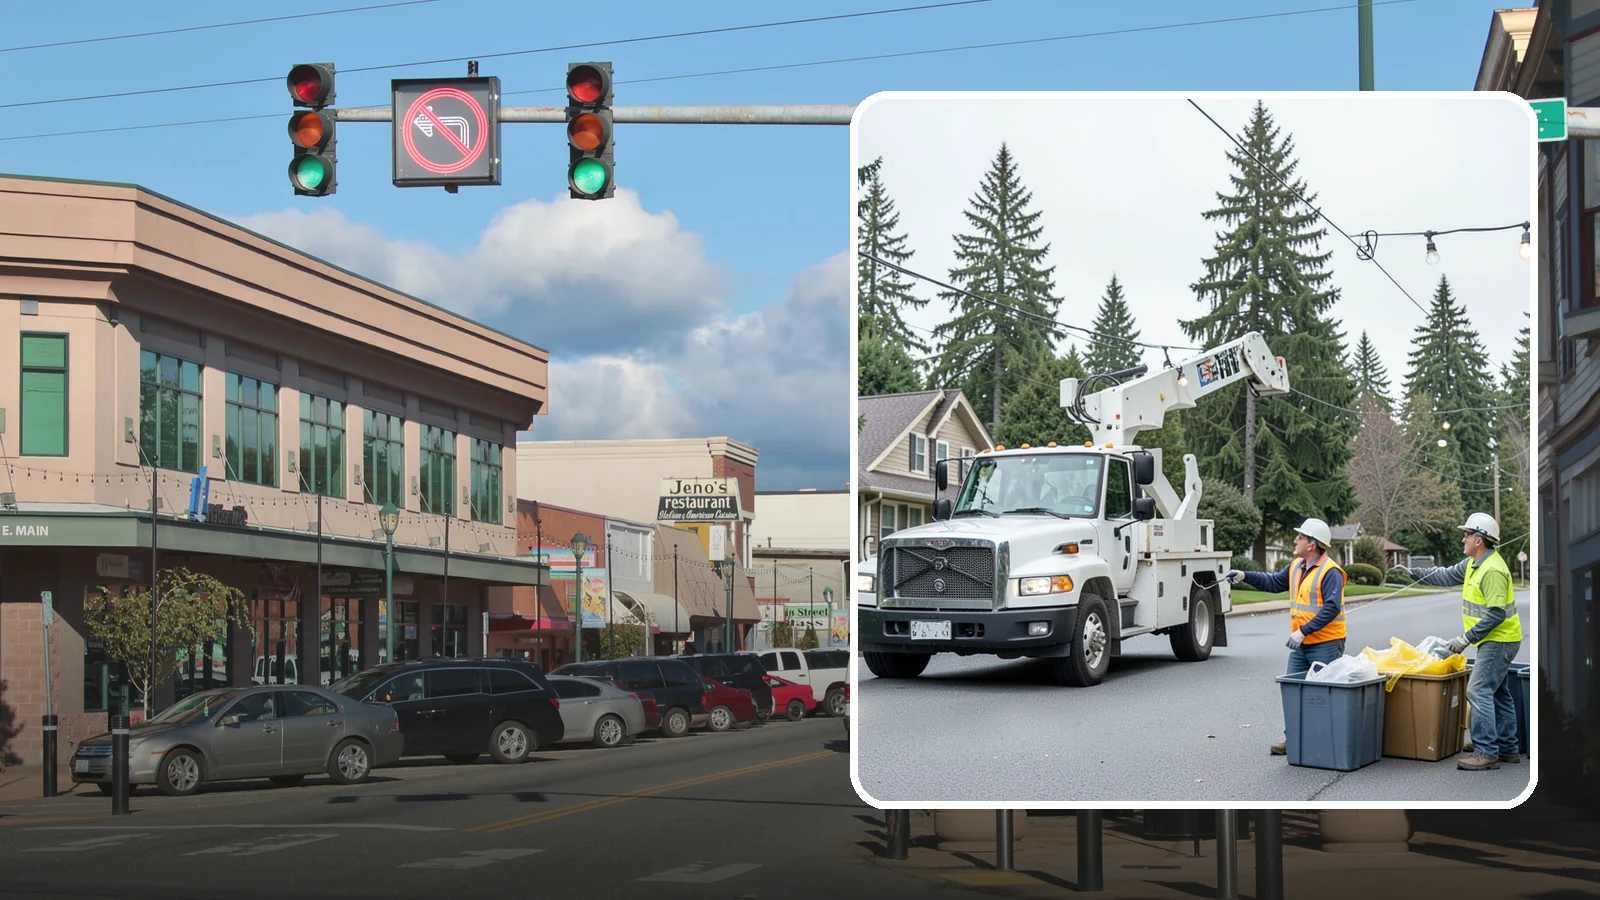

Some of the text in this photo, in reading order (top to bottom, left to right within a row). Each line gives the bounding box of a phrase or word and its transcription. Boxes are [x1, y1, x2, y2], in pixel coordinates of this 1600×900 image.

[670, 480, 728, 495] Jeno's
[665, 497, 731, 509] restaurant
[658, 510, 681, 520] Italian
[686, 510, 715, 520] American
[715, 509, 738, 520] Cuisine
[2, 526, 49, 536] E. MAIN
[785, 607, 795, 617] in
[797, 608, 829, 617] Street
[791, 619, 824, 627] lass
